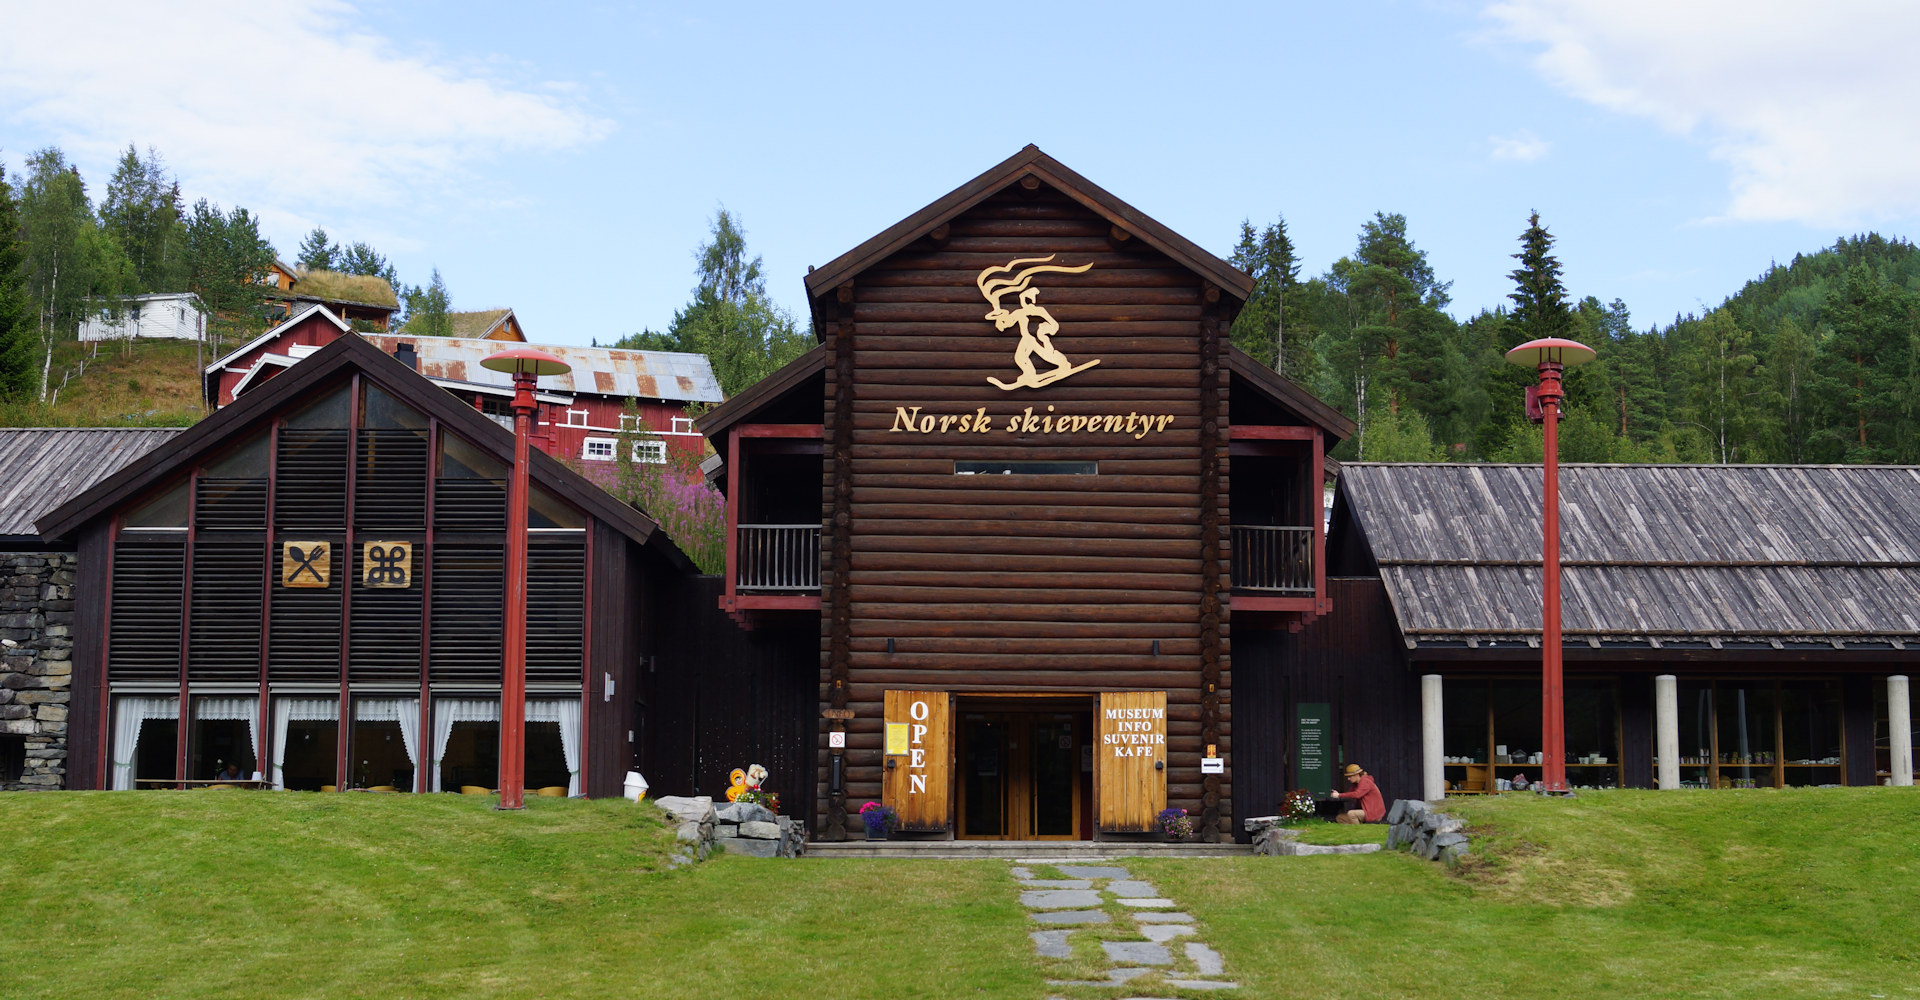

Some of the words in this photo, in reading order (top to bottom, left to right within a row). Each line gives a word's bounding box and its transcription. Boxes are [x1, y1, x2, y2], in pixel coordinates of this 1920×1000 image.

[889, 406, 992, 434] Norsk
[1006, 404, 1175, 440] skieventyr
[1105, 708, 1164, 720] MUSEUM
[1118, 721, 1152, 732] INFO
[1103, 733, 1165, 745] SUVENIR
[909, 701, 929, 794] OPEN
[1115, 746, 1153, 757] KAFE
